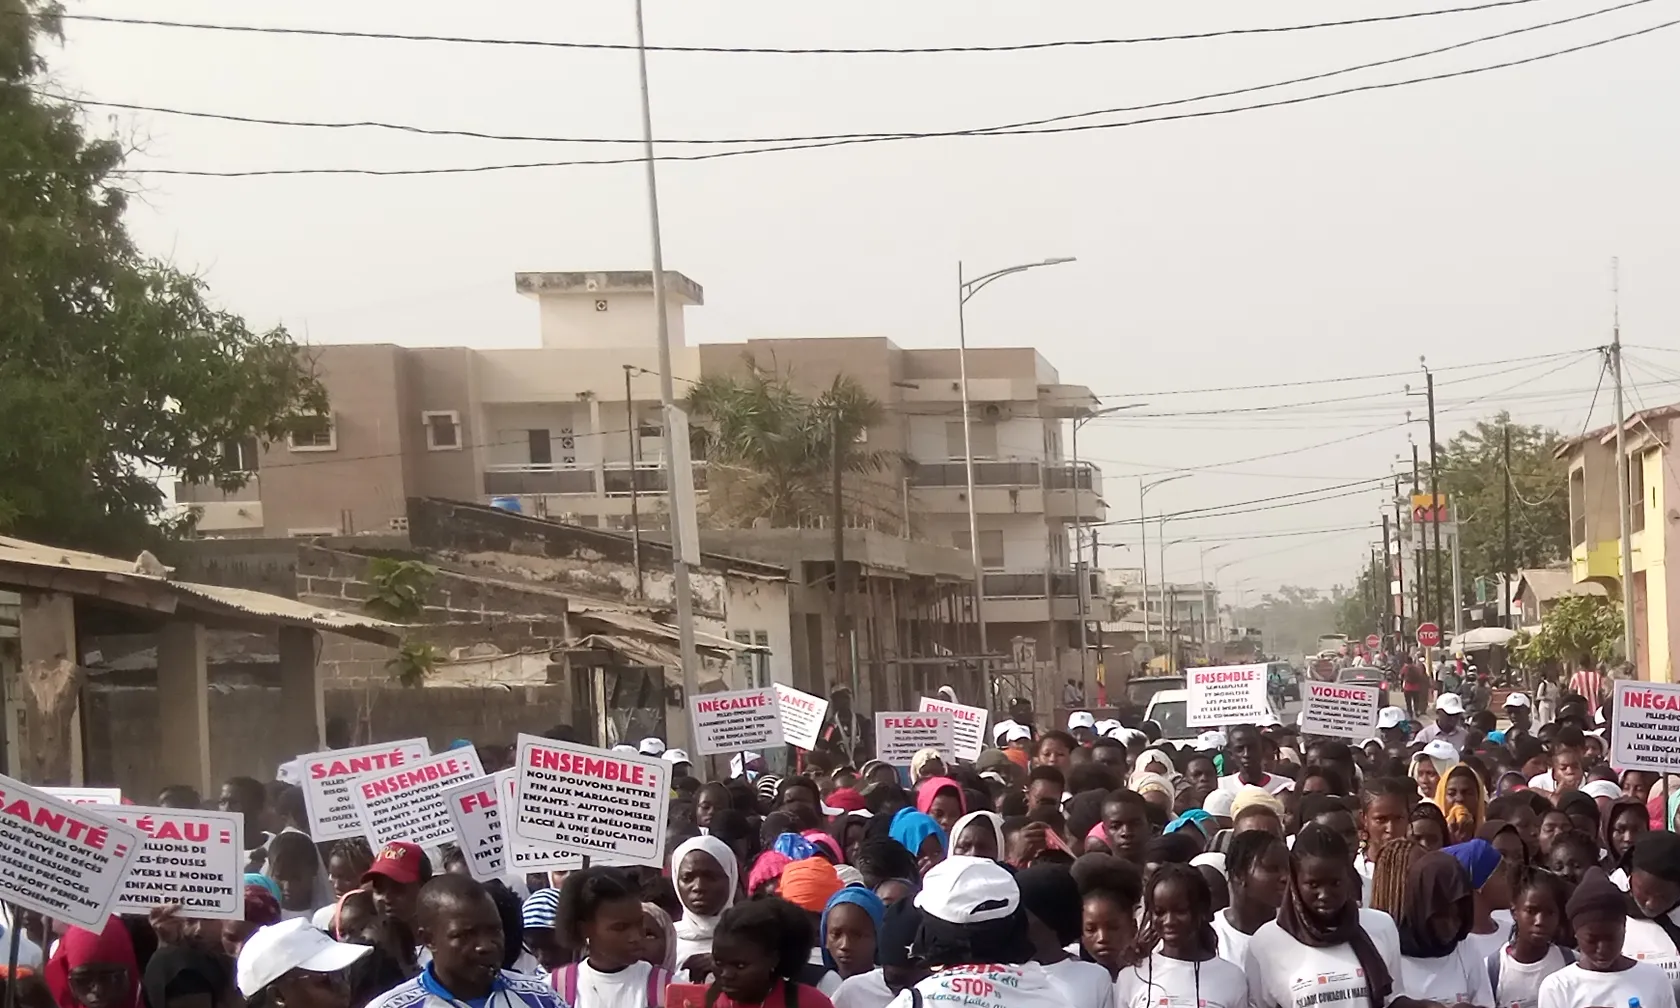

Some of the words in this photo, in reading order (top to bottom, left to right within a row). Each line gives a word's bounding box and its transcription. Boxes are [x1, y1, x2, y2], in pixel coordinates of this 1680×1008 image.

[1195, 671, 1254, 684] ENSEMBLE
[698, 693, 766, 713] INÉGALITÉ
[1312, 686, 1366, 701] VIOLENCE
[884, 717, 939, 728] FLÉAU
[311, 748, 405, 779] SANTÉ
[530, 748, 644, 785] ENSEMBLE
[361, 759, 460, 800] ENSEMBLE
[527, 770, 556, 781] NOUS
[560, 776, 613, 791] POUVONS
[616, 785, 656, 799] METTRE
[367, 798, 392, 808] NOUS
[394, 783, 440, 800] POUVONS
[523, 793, 568, 806] ENFANTS
[578, 802, 656, 822] AUTONOMISER
[531, 782, 547, 791] FIN
[550, 786, 572, 796] AUX
[574, 789, 629, 805] MARIAGES
[632, 801, 651, 809] DES
[525, 805, 541, 814] LES
[544, 808, 574, 819] FILLES
[591, 815, 652, 832] AMÉLIORER
[568, 824, 589, 833] UNE
[592, 826, 654, 844] ÉDUCATION
[29, 854, 81, 878] BLESSURES
[180, 872, 223, 881] MONDE
[17, 874, 49, 890] MORT
[51, 886, 99, 909] PENDANT
[181, 882, 232, 895] ABRUPTE
